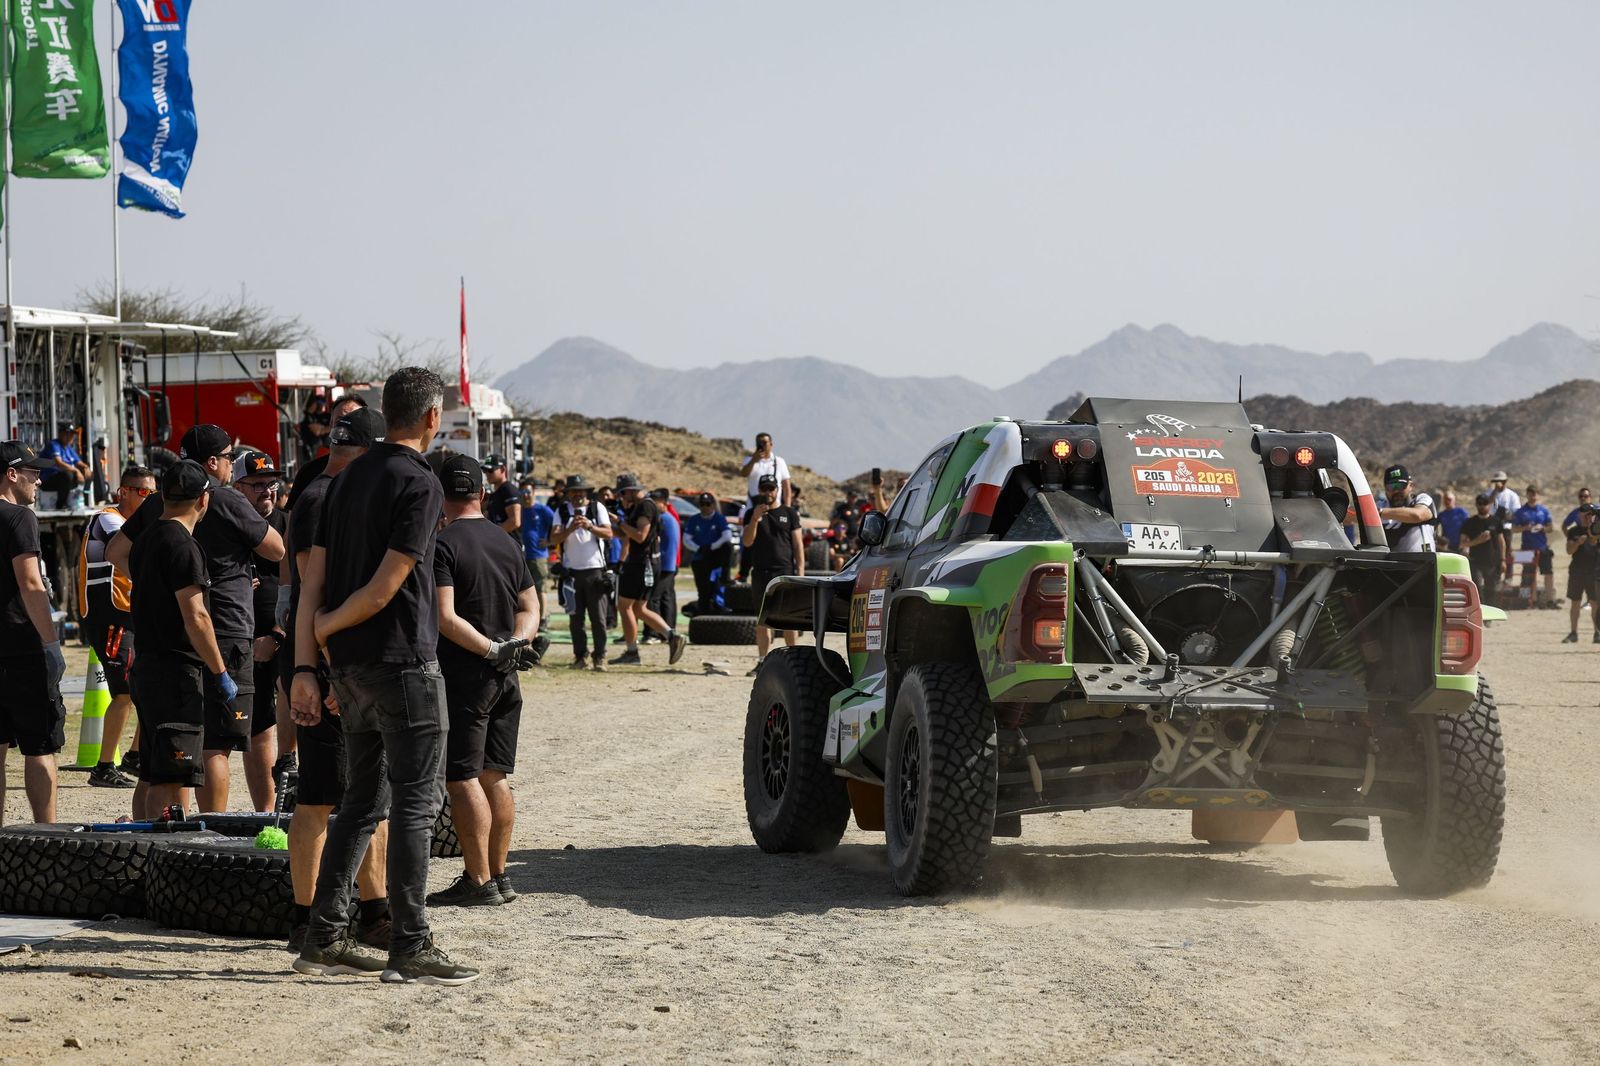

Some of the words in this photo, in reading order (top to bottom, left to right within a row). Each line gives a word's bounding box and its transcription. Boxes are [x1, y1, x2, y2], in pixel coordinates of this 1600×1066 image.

[260, 358, 273, 369] C1
[1134, 436, 1224, 448] ENERGY
[1135, 447, 1225, 459] LANDIA
[1144, 471, 1166, 481] 205
[1197, 472, 1235, 484] 2026
[1152, 482, 1183, 492] SAUDI
[1184, 483, 1223, 494] ARABIA
[1141, 526, 1162, 541] AA
